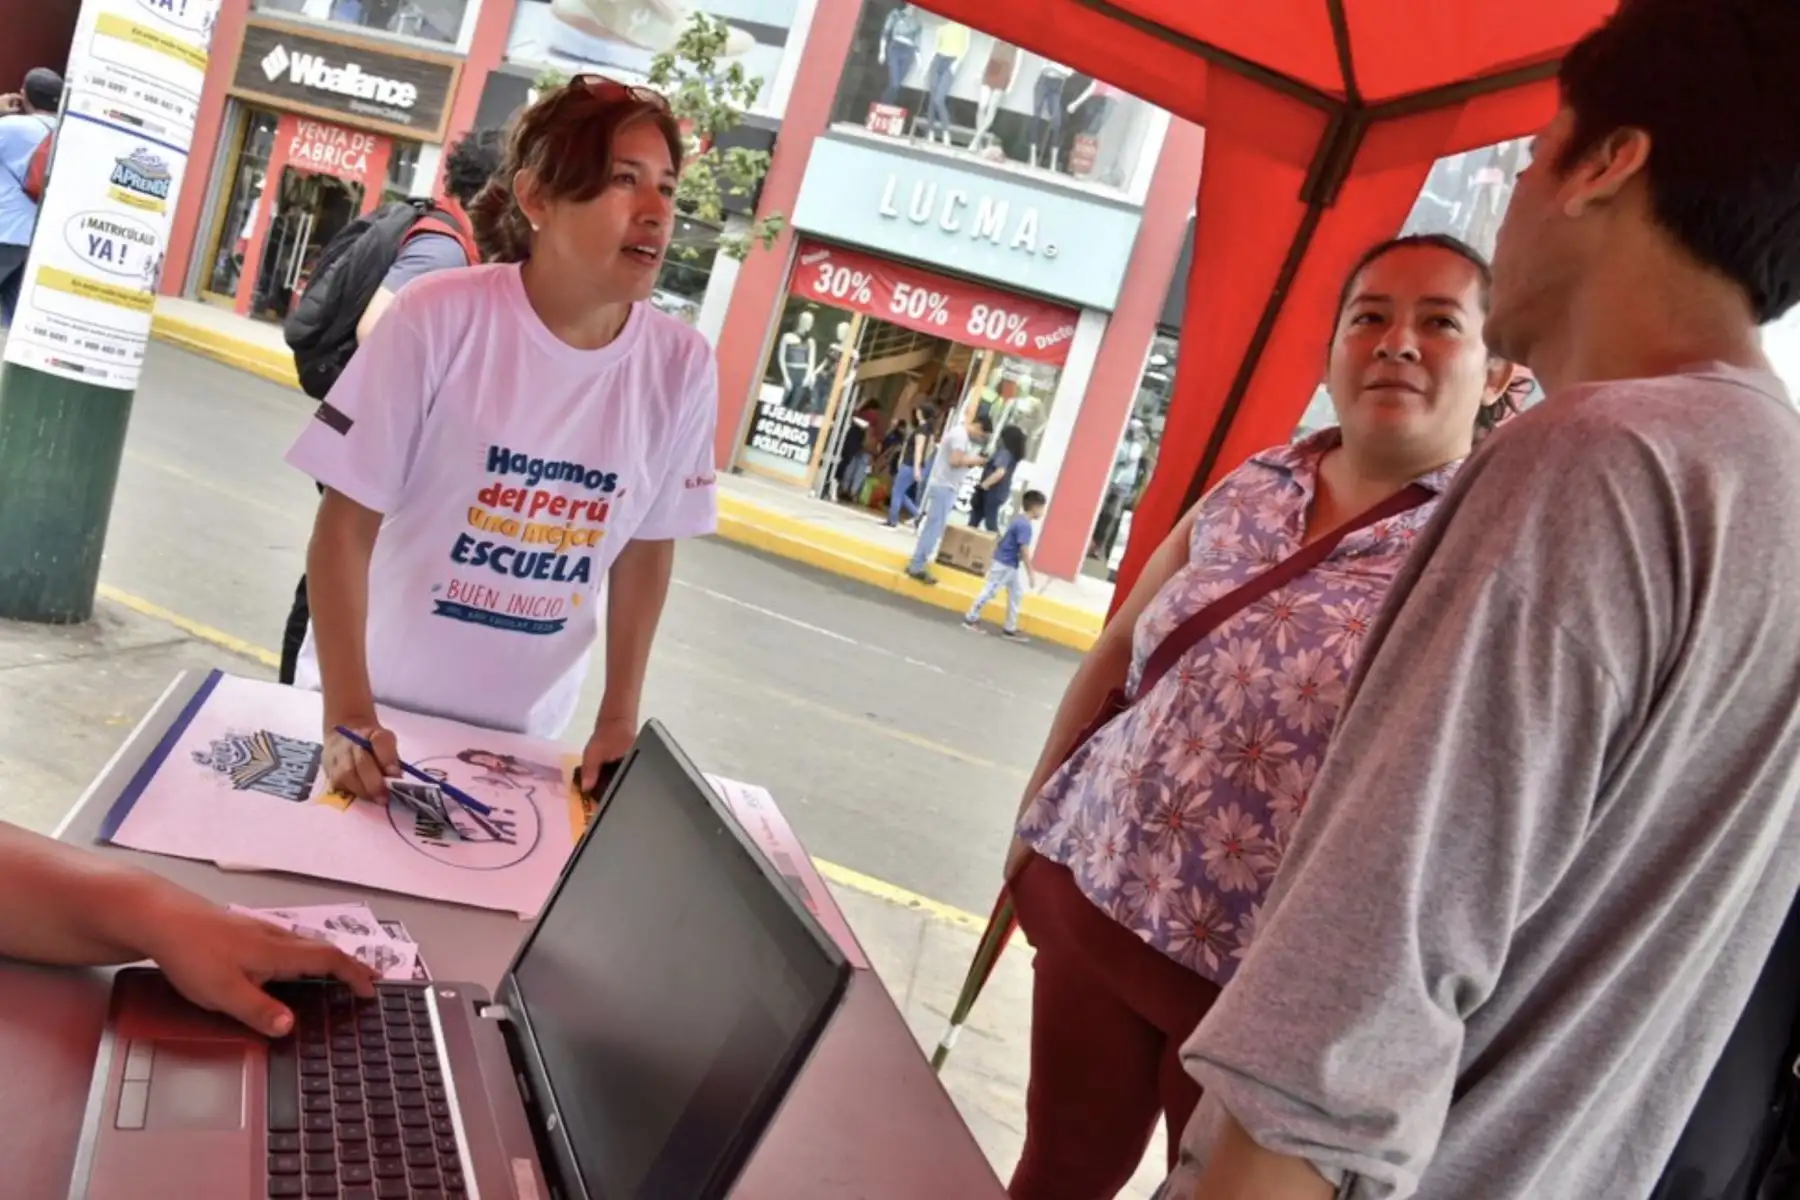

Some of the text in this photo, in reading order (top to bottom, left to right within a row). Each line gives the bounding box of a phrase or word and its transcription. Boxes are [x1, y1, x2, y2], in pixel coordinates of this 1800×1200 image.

[289, 136, 367, 173] FABRICA
[297, 120, 377, 154] VENTA DE
[878, 173, 1040, 255] LUCMA
[813, 262, 873, 305] 30%
[889, 281, 949, 326] 50%
[966, 304, 1028, 348] 80%
[486, 445, 618, 493] Hagamos
[478, 482, 527, 513] del
[520, 520, 606, 553] mejor
[450, 532, 592, 584] ESCUELA
[447, 578, 500, 609] BUEN
[506, 592, 566, 618] INICIO
